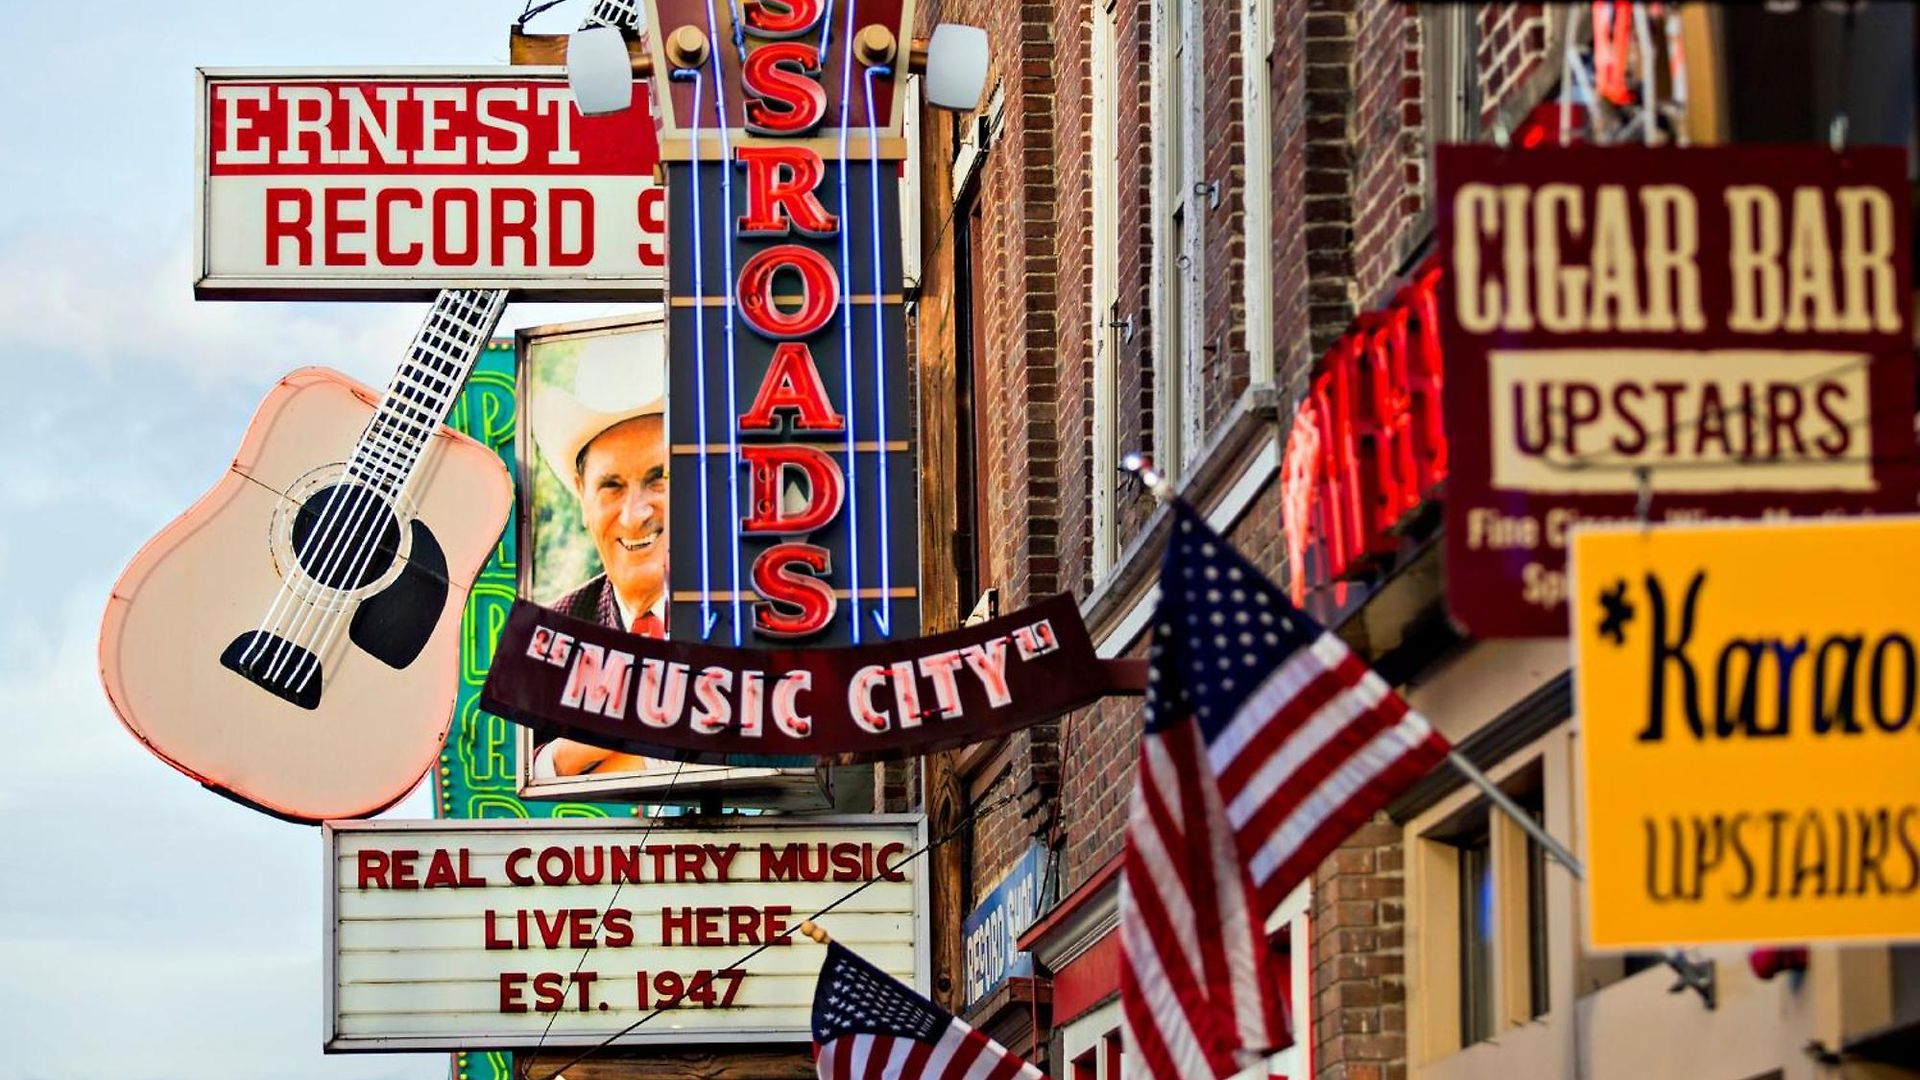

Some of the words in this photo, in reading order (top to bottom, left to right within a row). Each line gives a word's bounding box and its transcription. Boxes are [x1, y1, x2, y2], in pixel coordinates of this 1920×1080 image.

[215, 86, 582, 165] ERNEST
[265, 187, 596, 266] RECORD
[1453, 182, 1705, 334] CIGAR
[1726, 184, 1902, 334] BAR
[1513, 380, 1852, 457] UPSTAIRS
[1468, 508, 1540, 550] Fine
[357, 848, 486, 889] REAL
[505, 844, 738, 886] COUNTRY
[759, 841, 906, 882] MUSIC
[1645, 806, 1920, 903] UPSTAIRS
[484, 908, 634, 950] LIVES
[661, 905, 794, 946] HERE
[499, 970, 609, 1014] EST.
[636, 968, 748, 1010] 1947
